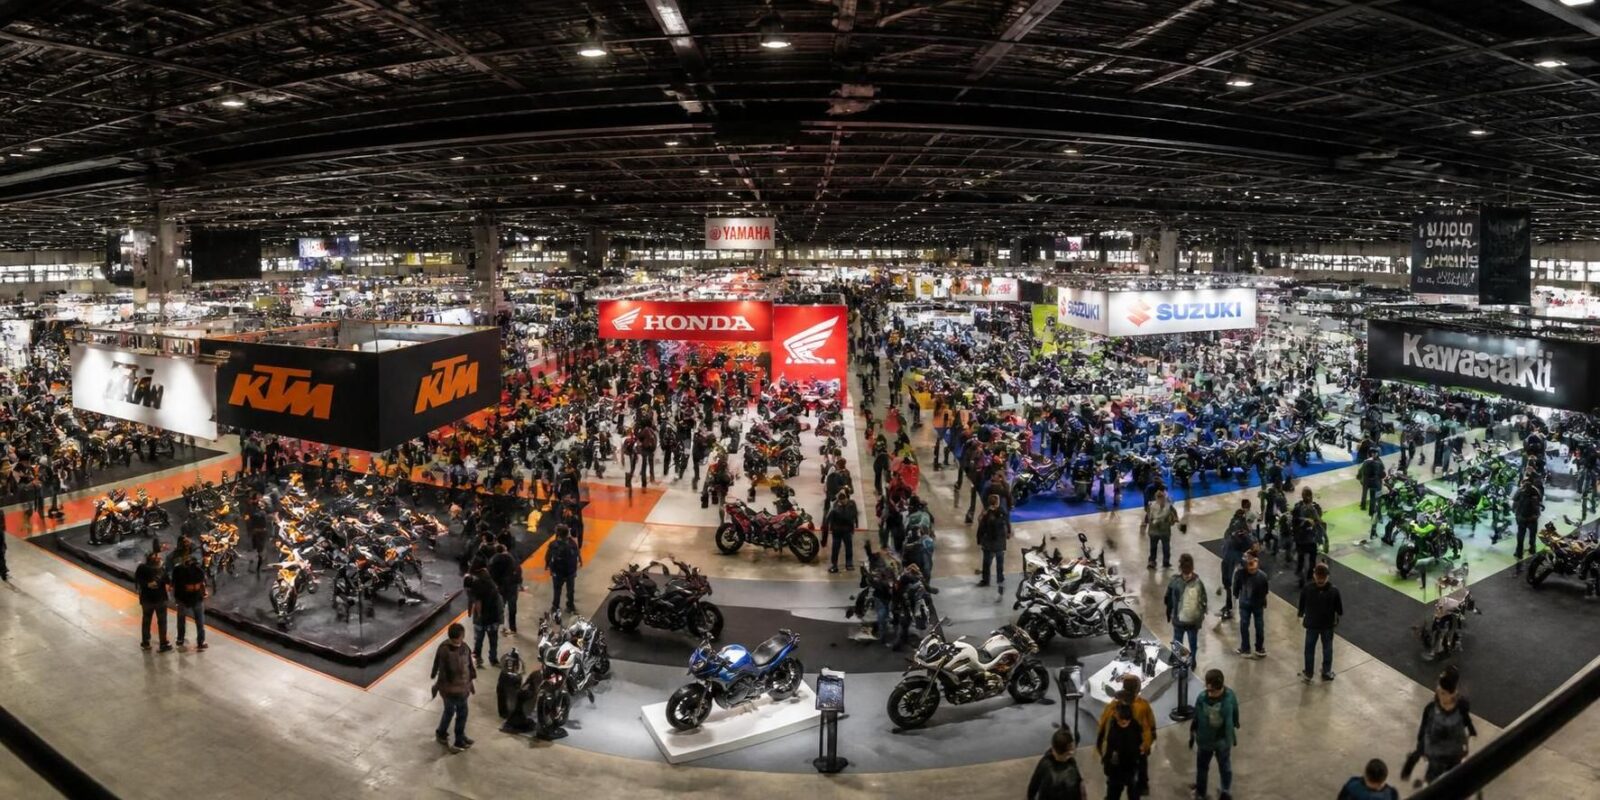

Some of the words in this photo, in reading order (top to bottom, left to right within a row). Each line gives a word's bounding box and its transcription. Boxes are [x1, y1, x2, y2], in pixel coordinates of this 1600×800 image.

[723, 226, 771, 240] YAMAHA
[1156, 302, 1242, 321] SUZUKI
[643, 315, 755, 331] HONDA
[228, 364, 334, 420] KTM
[414, 354, 479, 415] KTM
